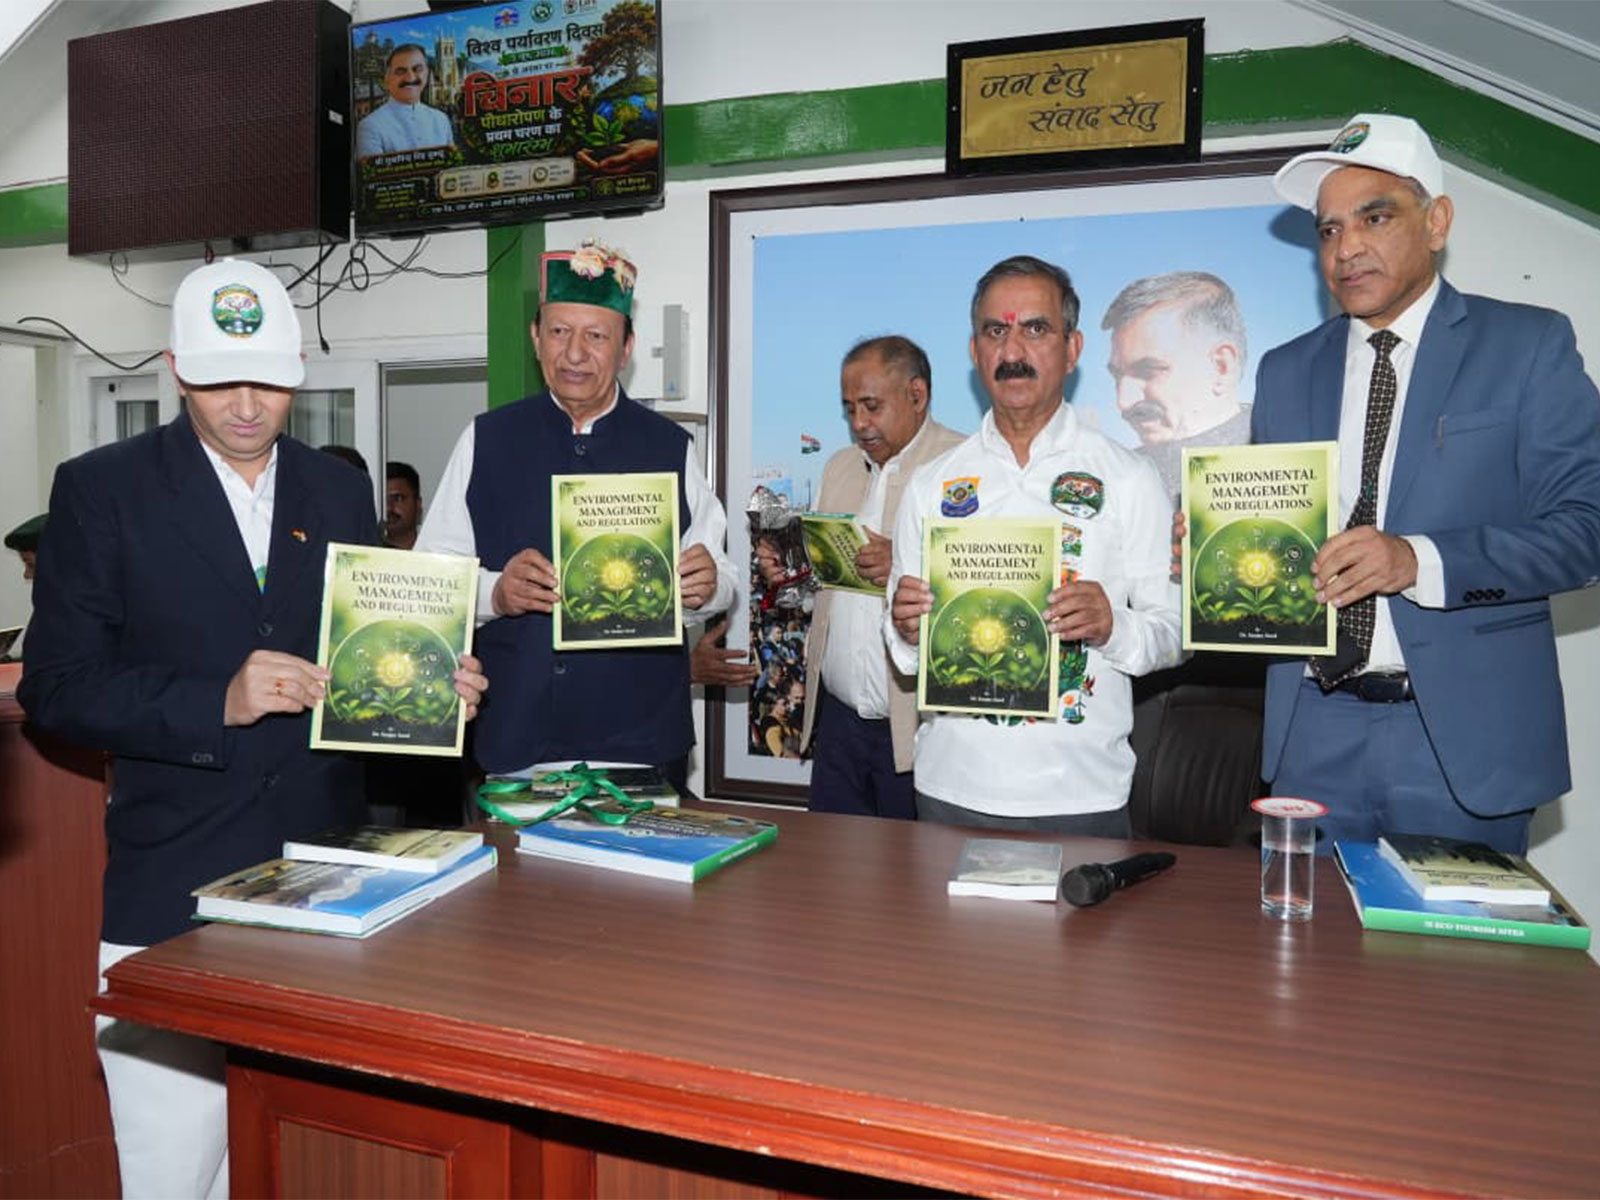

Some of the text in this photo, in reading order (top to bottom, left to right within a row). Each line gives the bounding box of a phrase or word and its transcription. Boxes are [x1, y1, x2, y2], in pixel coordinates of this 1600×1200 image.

[466, 38, 502, 57] विश्व
[505, 29, 562, 50] पर्यावरण
[566, 22, 605, 41] दिवस
[980, 63, 1095, 99] जन हेतु
[461, 66, 595, 117] चिनार
[1028, 96, 1165, 134] संवाद सेतु
[485, 123, 562, 143] प्रथम चरण का
[1205, 469, 1318, 484] ENVIRONMENTAL
[1212, 484, 1309, 498] MANAGEMENT
[573, 493, 665, 505] ENVIRONMENTAL
[1208, 499, 1313, 511] AND REGULATIONS
[579, 505, 658, 517] MANAGEMENT
[576, 517, 662, 527] AND REGULATIONS
[945, 543, 1045, 555] ENVIRONMENTAL
[950, 557, 1038, 568] MANAGEMENT
[352, 570, 461, 590] ENVIRONMENTAL
[946, 571, 1041, 580] AND REGULATIONS
[357, 586, 454, 603] MANAGEMENT
[352, 600, 455, 615] AND REGULATIONS
